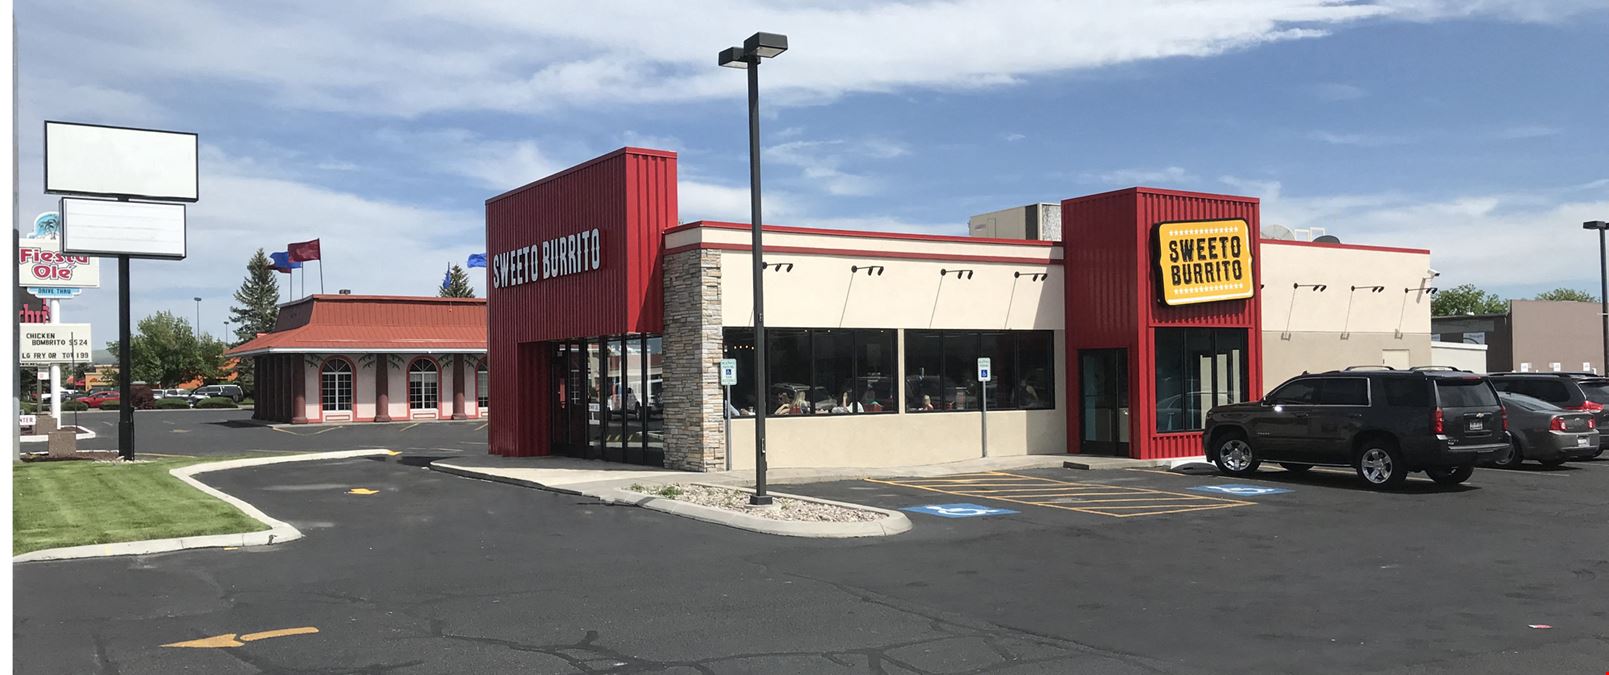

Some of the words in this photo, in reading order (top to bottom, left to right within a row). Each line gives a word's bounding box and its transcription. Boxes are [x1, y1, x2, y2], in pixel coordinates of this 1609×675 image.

[493, 244, 539, 289] SWEETO
[542, 227, 600, 280] BURRITO
[1168, 235, 1242, 263] SWEETO
[1170, 259, 1243, 287] BURRITO
